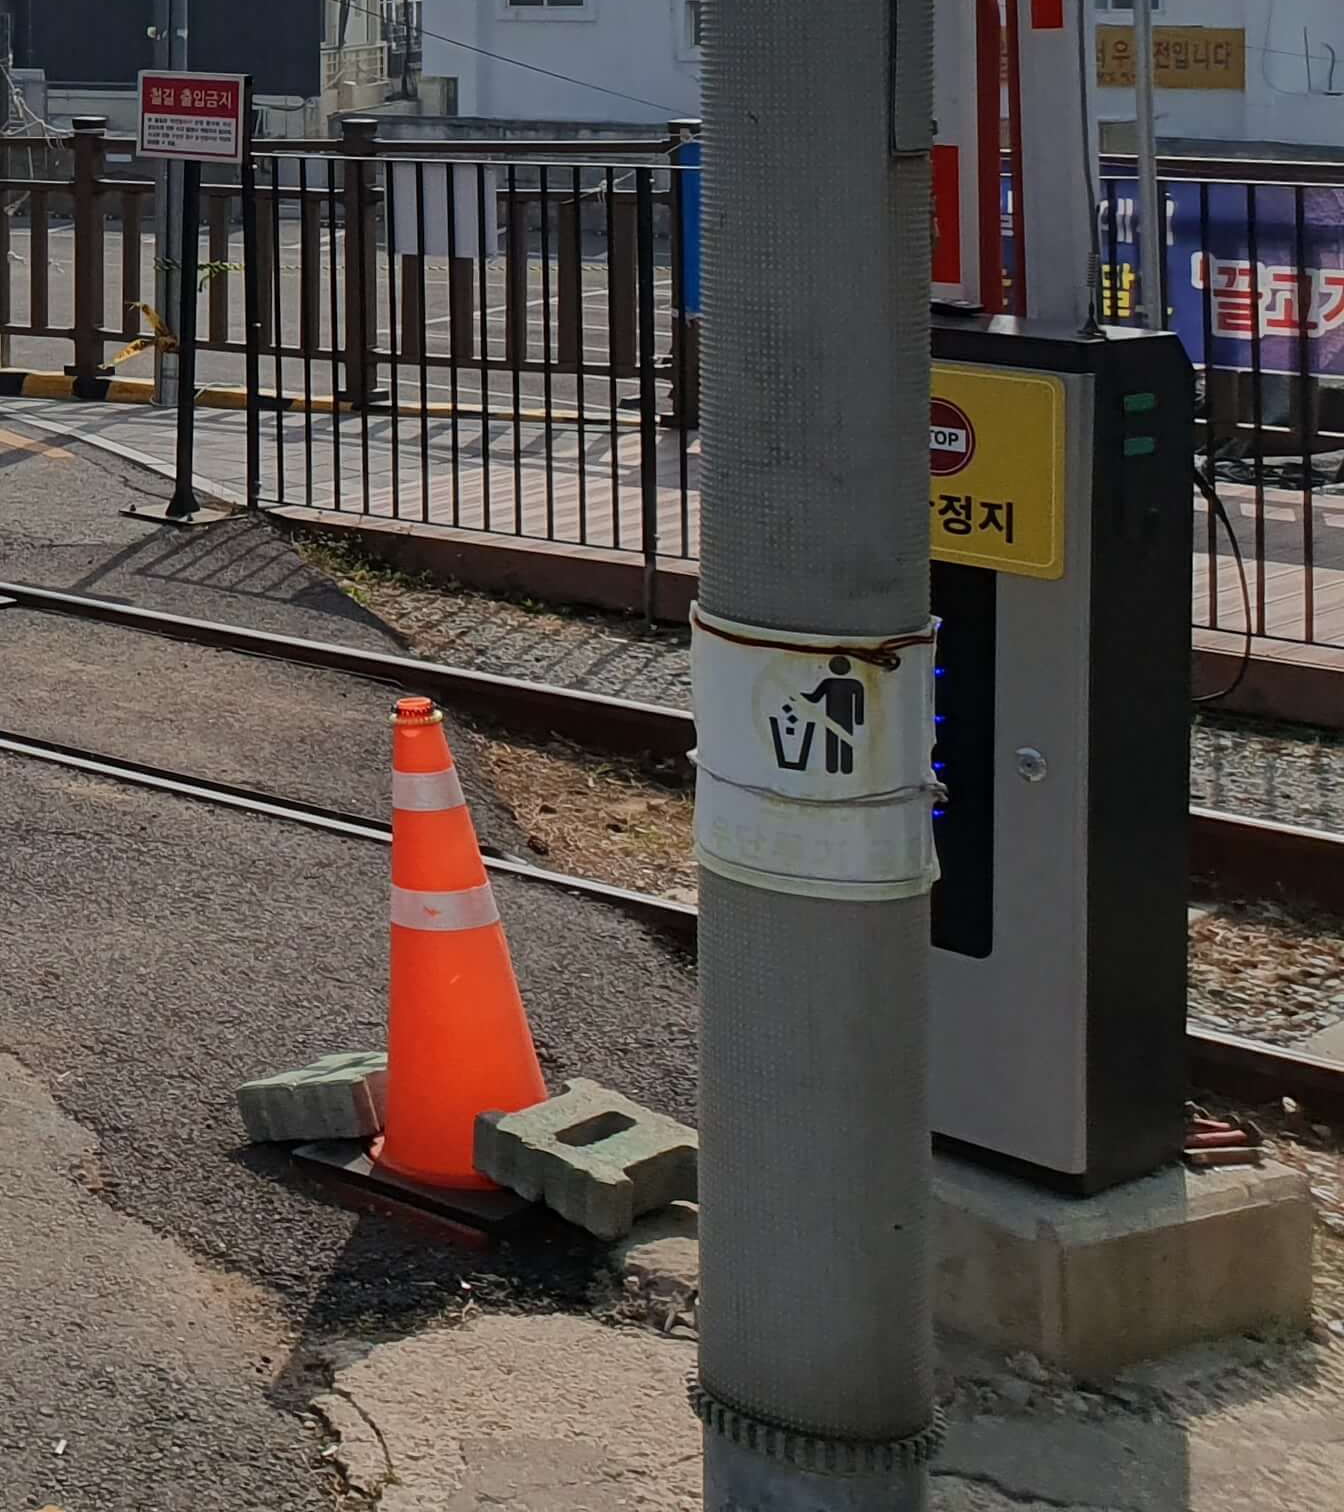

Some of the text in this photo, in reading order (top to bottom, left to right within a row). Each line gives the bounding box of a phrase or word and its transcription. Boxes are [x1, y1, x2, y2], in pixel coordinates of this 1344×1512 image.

[150, 87, 232, 109] 철길 출입금지
[930, 429, 959, 447] OP
[929, 494, 1014, 544] 정지
